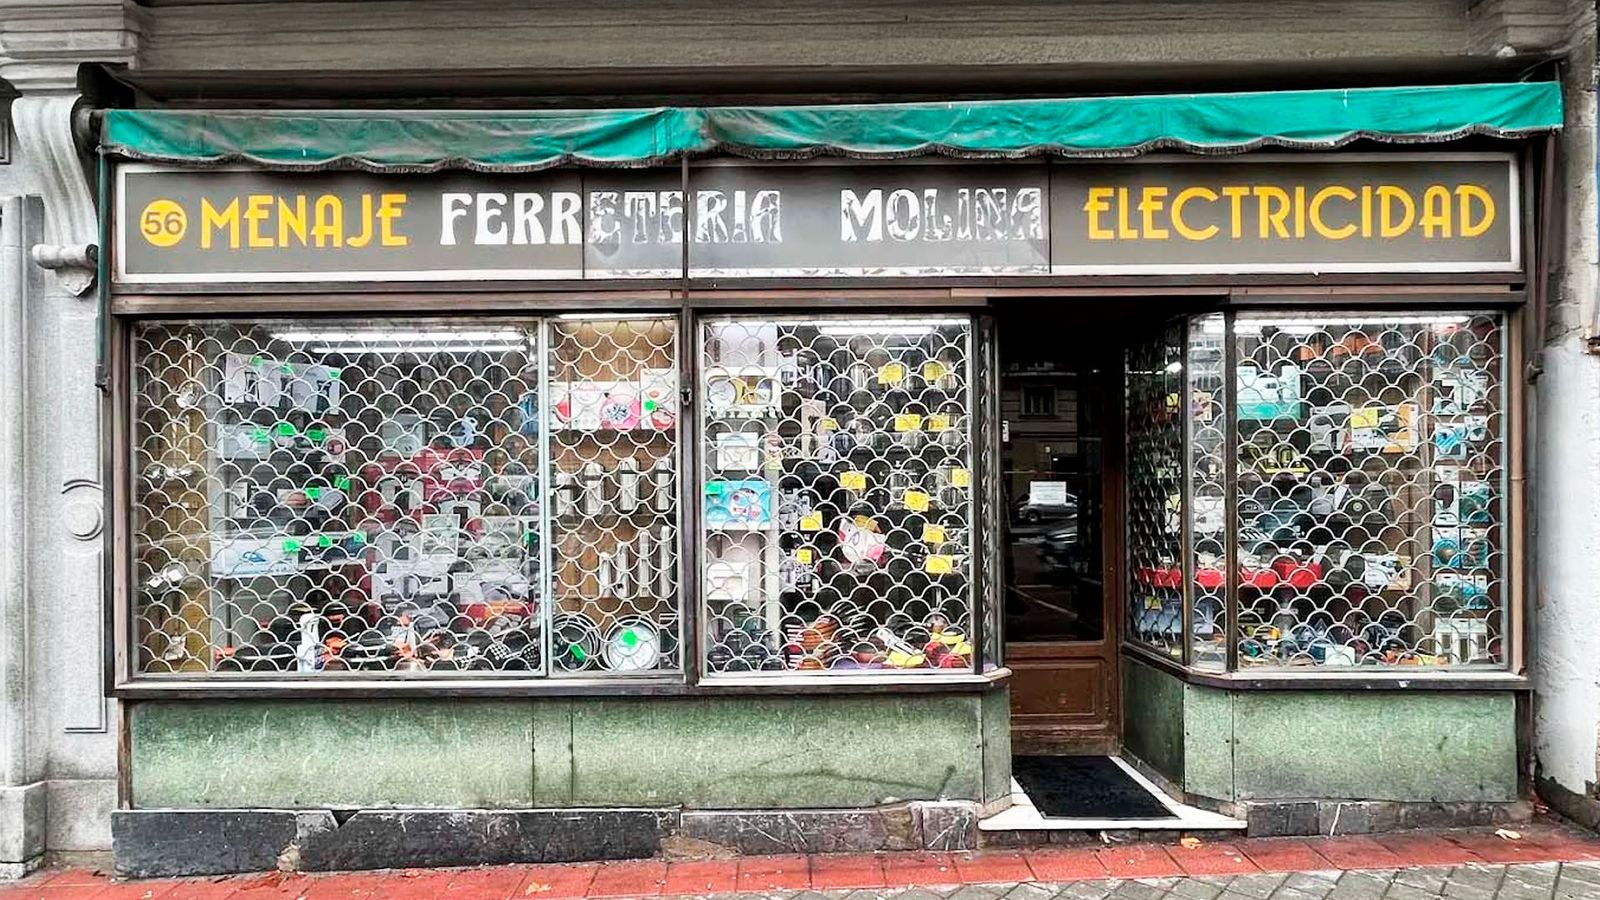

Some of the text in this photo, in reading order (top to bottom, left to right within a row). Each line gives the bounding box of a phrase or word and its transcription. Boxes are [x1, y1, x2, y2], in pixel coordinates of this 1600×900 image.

[143, 211, 183, 235] 56
[200, 193, 409, 249] MENAJE
[840, 187, 1043, 243] MOLINA
[1083, 185, 1496, 241] ELECTRICIDAD
